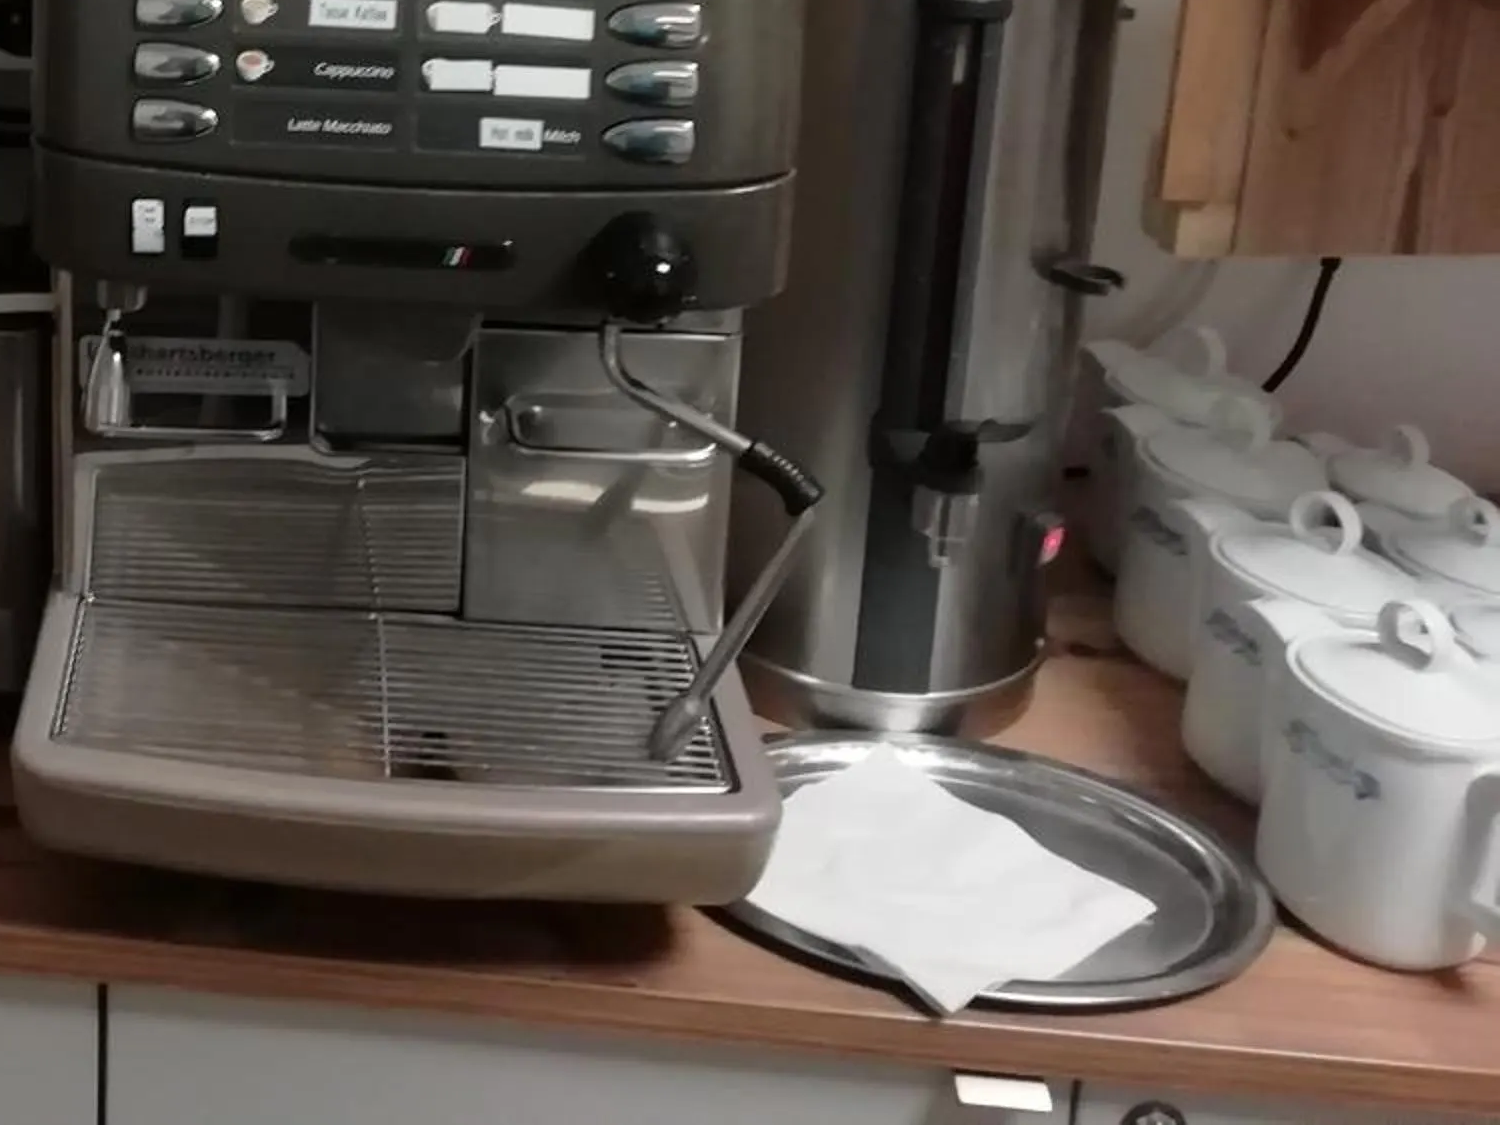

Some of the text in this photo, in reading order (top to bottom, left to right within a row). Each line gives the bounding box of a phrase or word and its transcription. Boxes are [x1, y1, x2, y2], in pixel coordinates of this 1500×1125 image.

[313, 62, 395, 80] Cappuccino
[287, 118, 393, 135] Latte Macchiato
